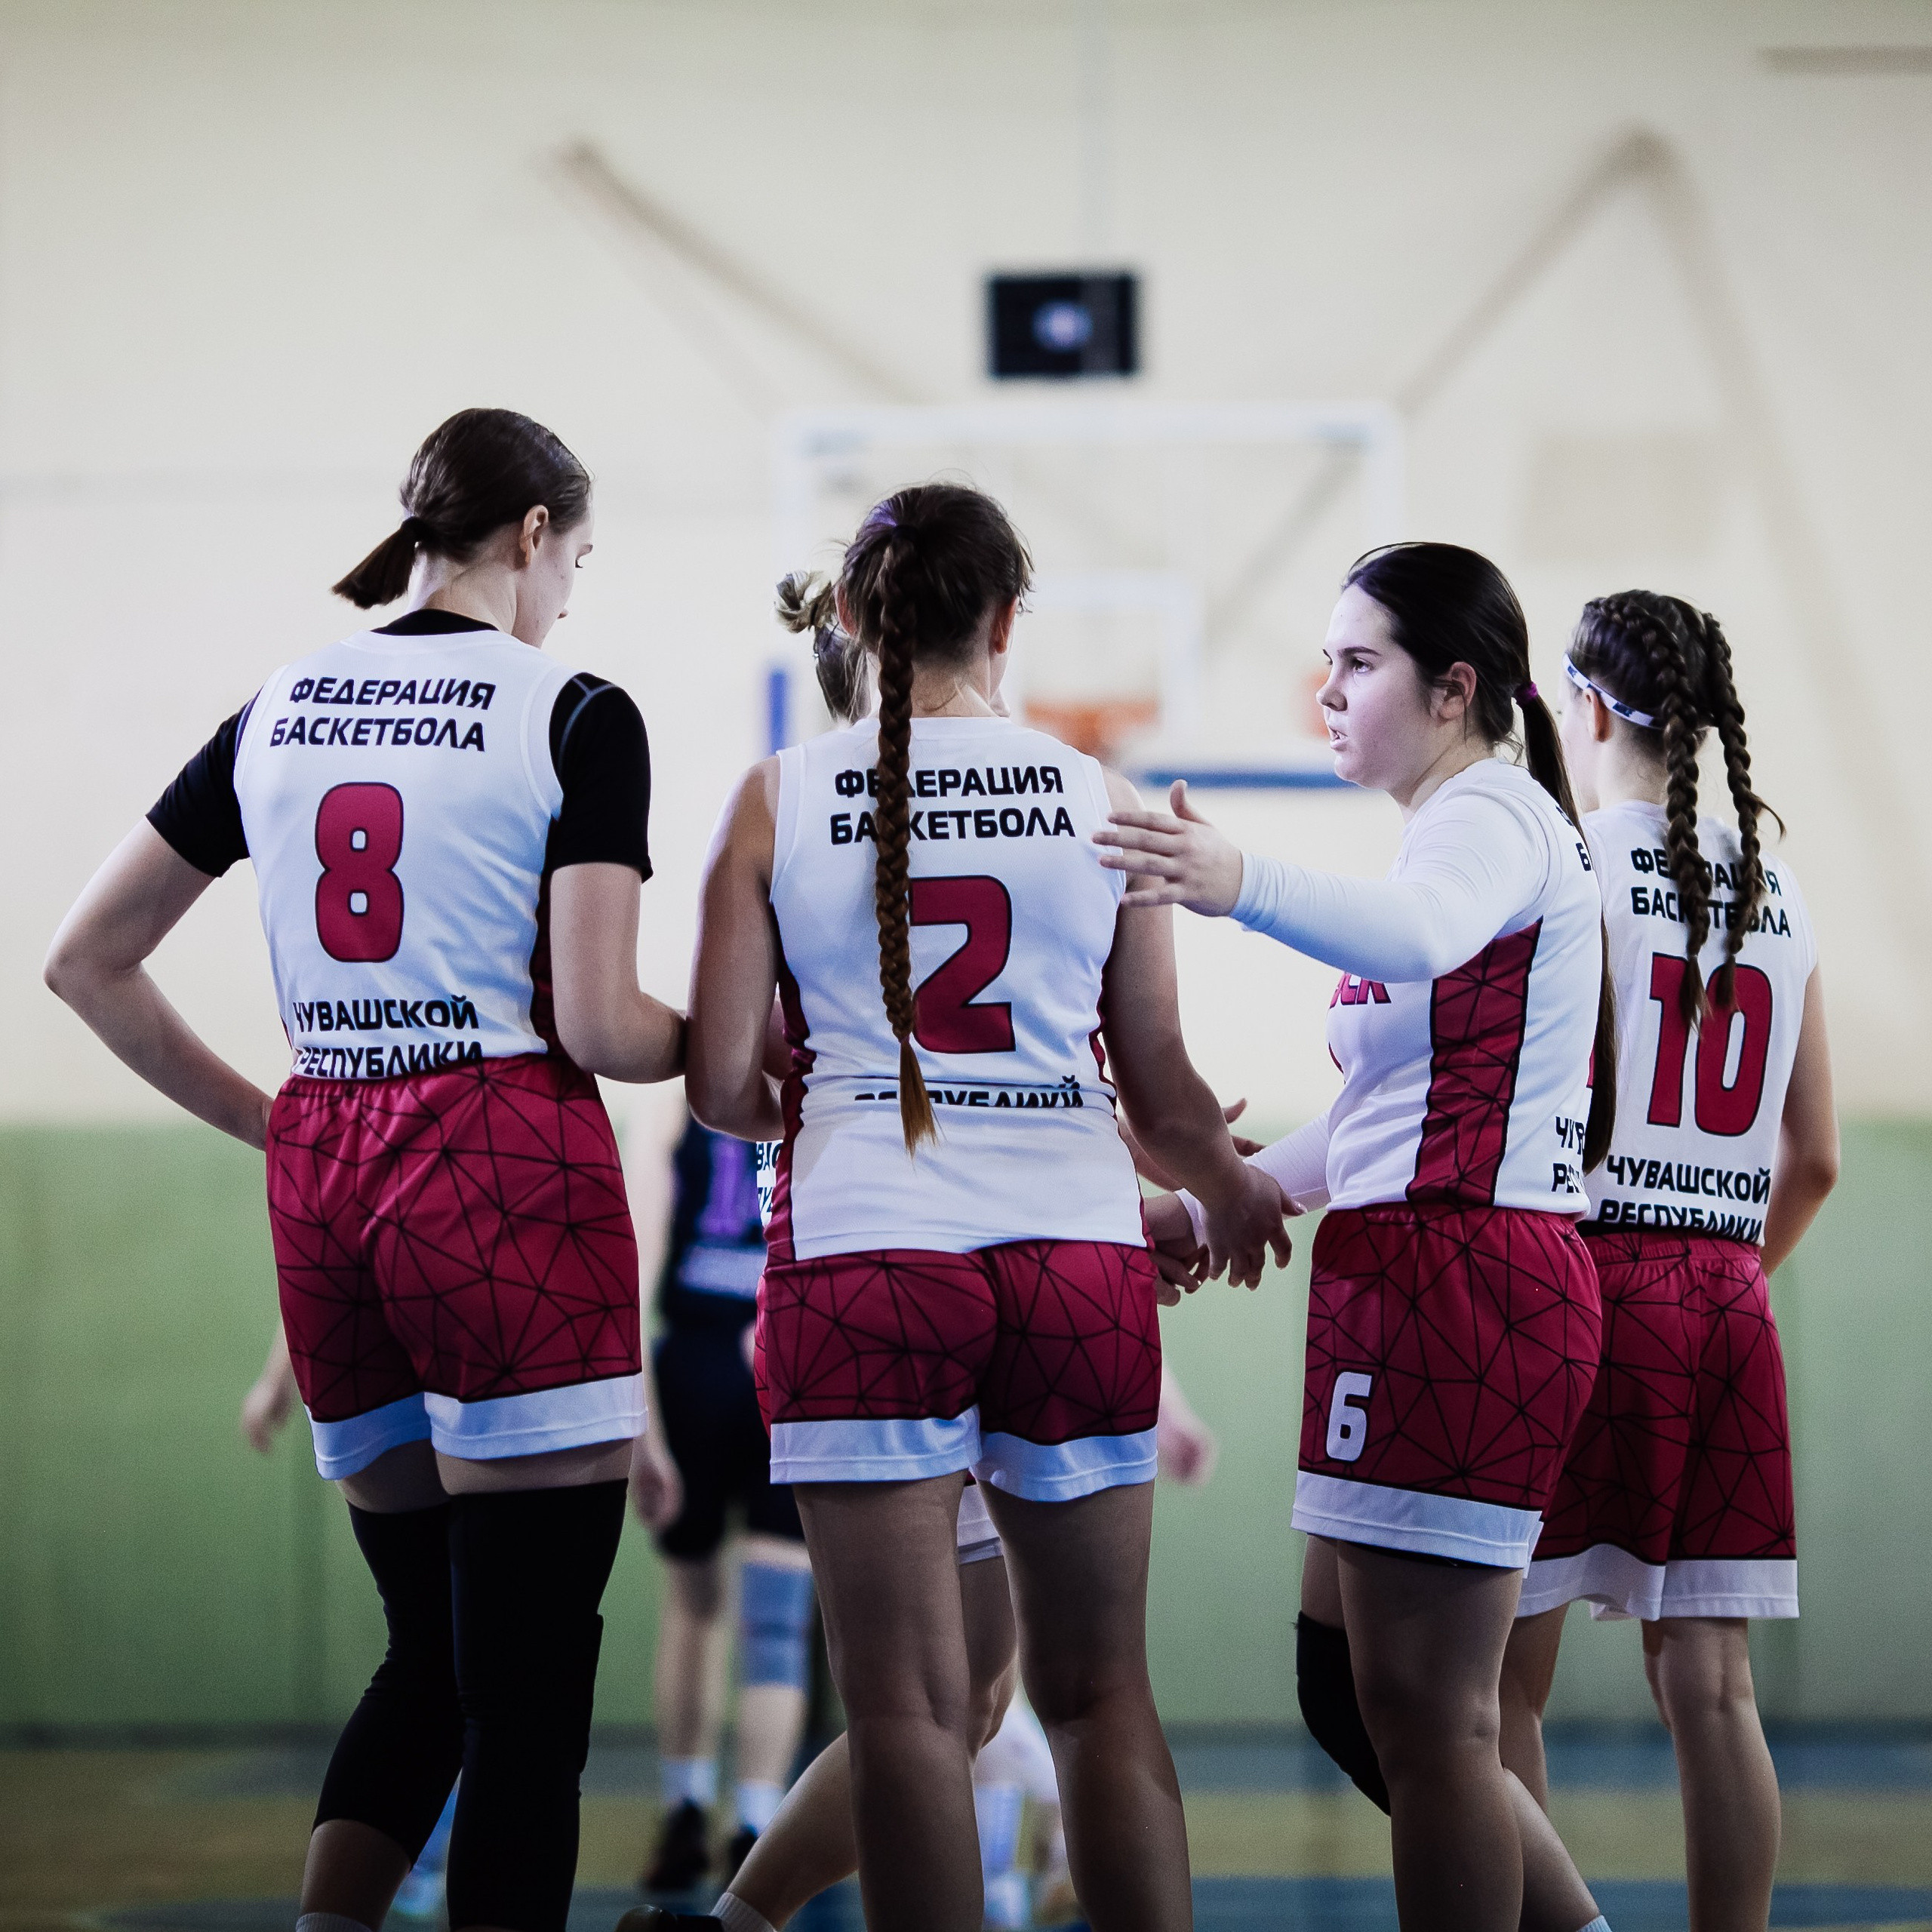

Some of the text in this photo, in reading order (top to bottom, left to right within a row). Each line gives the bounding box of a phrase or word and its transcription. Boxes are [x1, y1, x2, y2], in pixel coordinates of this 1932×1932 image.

[290, 677, 496, 710] ФЕДЕРАЦИЯ
[269, 716, 485, 752] БАСКЕТБОЛА
[835, 766, 1064, 798] ФЕЕРАЦИЯ
[830, 807, 1076, 845] БАКЕТБОЛА
[315, 782, 404, 962] 8
[909, 875, 1016, 1054] 2
[293, 995, 479, 1032] ЧУВАШСКОЙ
[1647, 952, 1774, 1137] 10
[1607, 1155, 1771, 1204] ЧУВАШСКОЙ
[1326, 1371, 1373, 1462] 6
